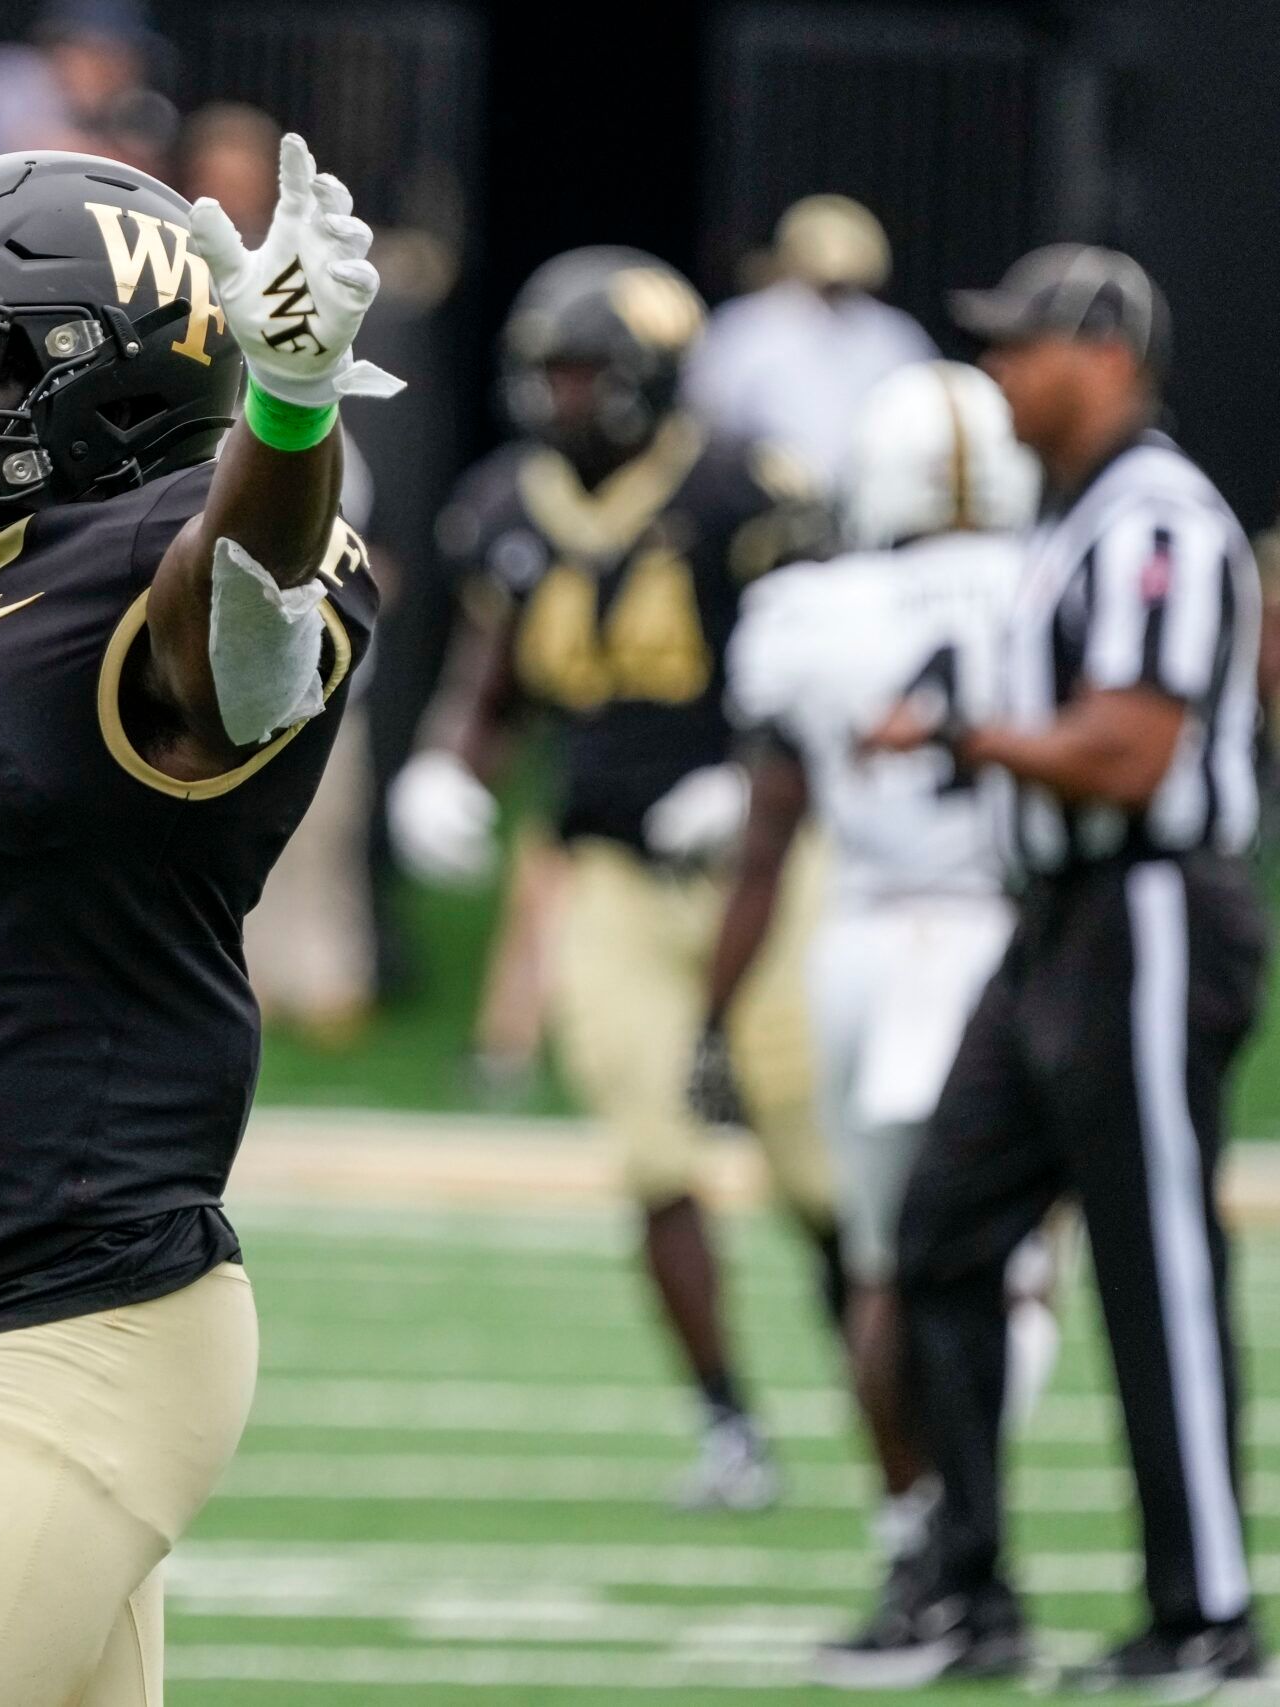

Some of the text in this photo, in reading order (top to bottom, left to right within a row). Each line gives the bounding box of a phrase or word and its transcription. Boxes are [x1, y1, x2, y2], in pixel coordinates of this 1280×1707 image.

[84, 201, 226, 367] WF
[262, 254, 329, 356] WF
[518, 548, 713, 712] 44
